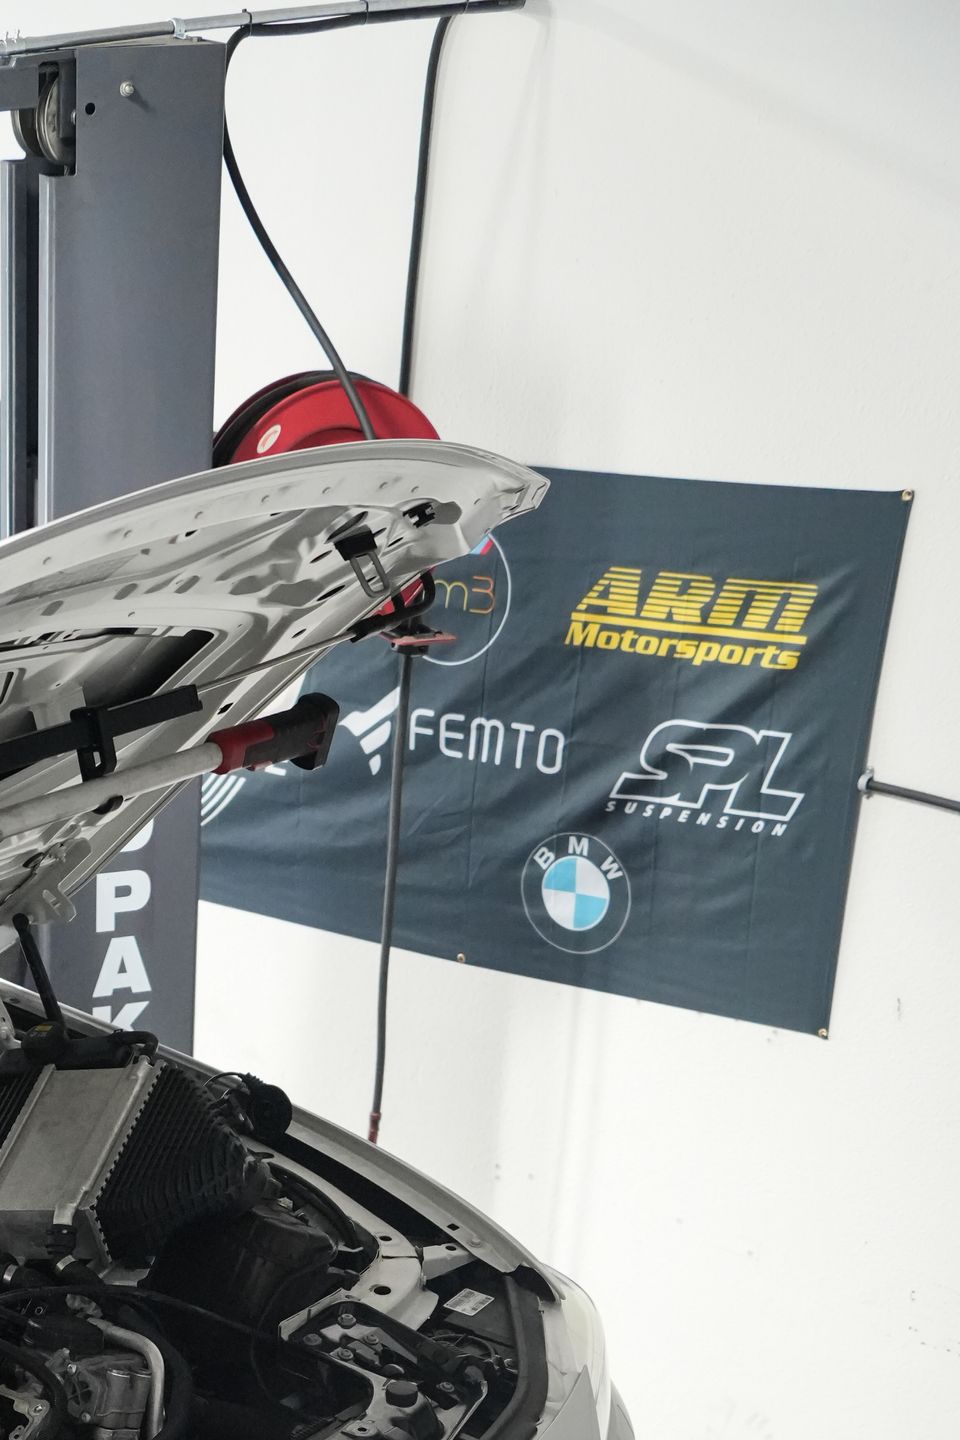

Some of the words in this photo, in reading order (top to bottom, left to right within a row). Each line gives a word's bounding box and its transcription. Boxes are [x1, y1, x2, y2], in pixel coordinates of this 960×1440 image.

[574, 566, 818, 633] ARM
[564, 621, 801, 670] Motorsports
[408, 708, 565, 774] FEMTO
[605, 801, 787, 837] SUSPENSION
[533, 835, 623, 882] BMW
